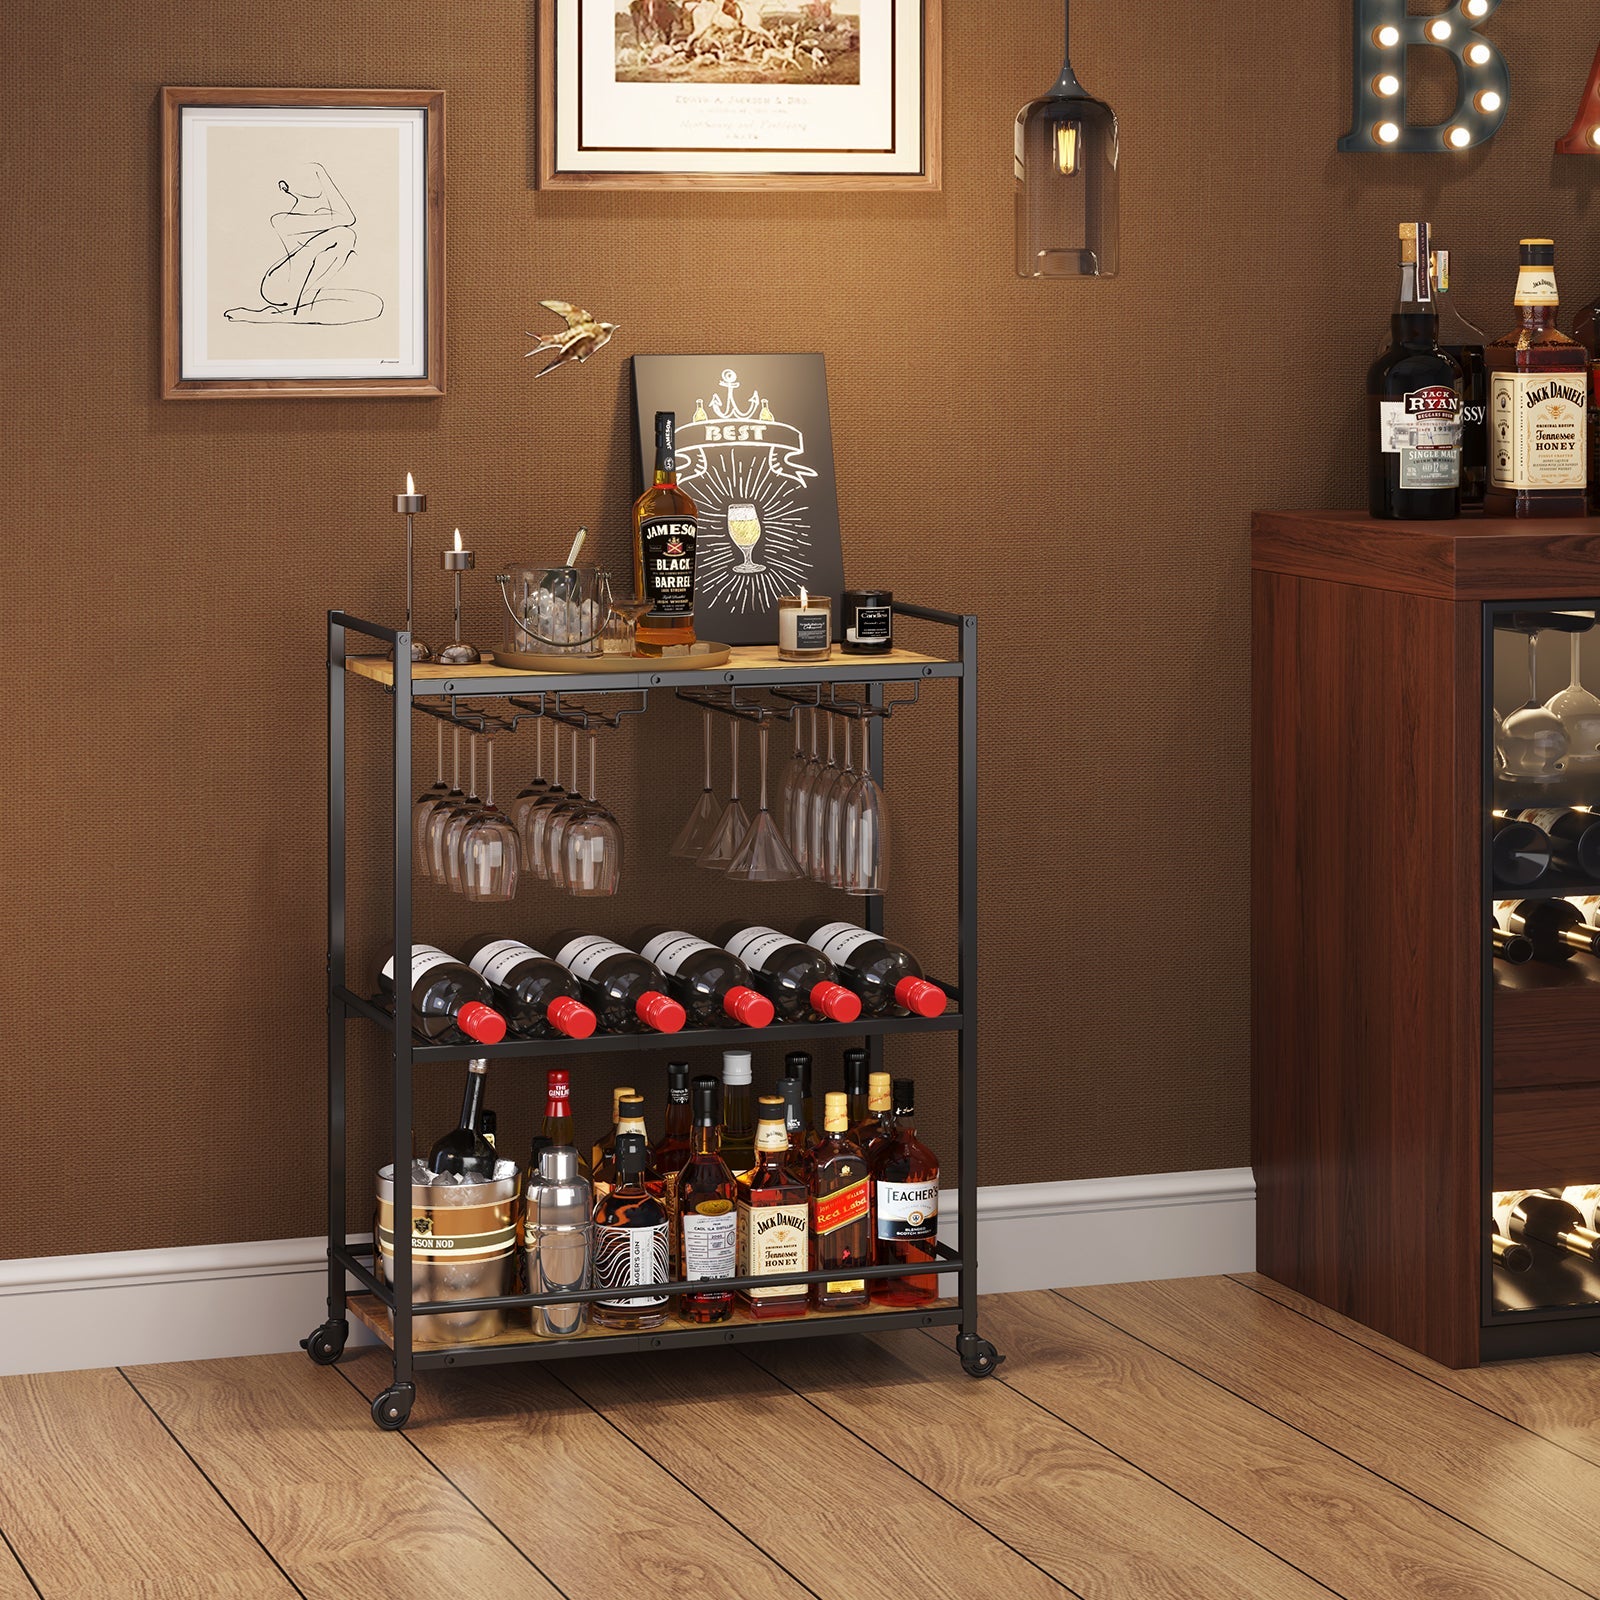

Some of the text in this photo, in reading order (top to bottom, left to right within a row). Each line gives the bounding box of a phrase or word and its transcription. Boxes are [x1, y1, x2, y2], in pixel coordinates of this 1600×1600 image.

[1422, 391, 1450, 399] JACK
[1526, 386, 1550, 409] JACK
[1550, 381, 1585, 408] DANIEL'S
[1409, 397, 1459, 411] RYAN
[664, 419, 673, 450] JAMESON
[704, 424, 768, 441] BEST
[1535, 429, 1576, 441] Tennessee
[1535, 442, 1577, 451] HONEY
[1409, 450, 1440, 460] SINGLE
[646, 523, 696, 540] JAMESON
[656, 558, 691, 571] BLACK
[655, 575, 691, 588] BARREL
[817, 1209, 841, 1224] Red
[757, 1212, 806, 1236] JACK DANIEL'S
[435, 1239, 455, 1249] NOD
[633, 1241, 641, 1255] GIN
[764, 1250, 798, 1260] Tennessee
[765, 1258, 798, 1268] HONEY
